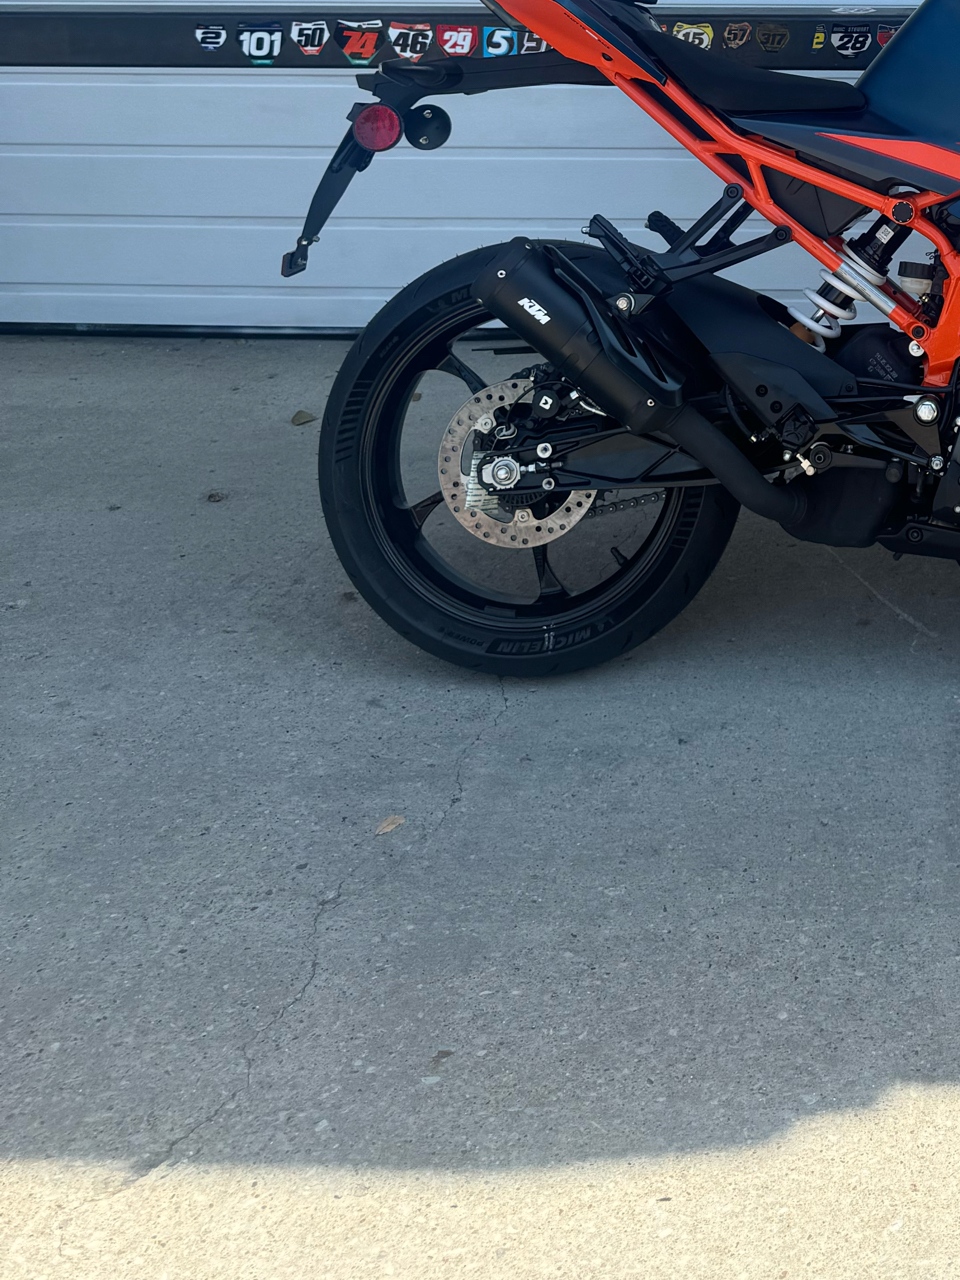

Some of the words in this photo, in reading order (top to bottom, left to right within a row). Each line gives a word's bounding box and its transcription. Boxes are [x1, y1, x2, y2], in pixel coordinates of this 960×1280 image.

[199, 30, 222, 45] 2
[238, 31, 283, 57] 101
[297, 27, 325, 48] 50
[342, 30, 379, 58] 74
[392, 31, 430, 55] 46
[442, 31, 473, 54] 29
[487, 30, 511, 55] 5
[726, 29, 749, 42] 57
[761, 32, 787, 46] 317
[836, 33, 870, 51] 28
[517, 297, 552, 325] KTM
[496, 626, 593, 654] MICHELIN
